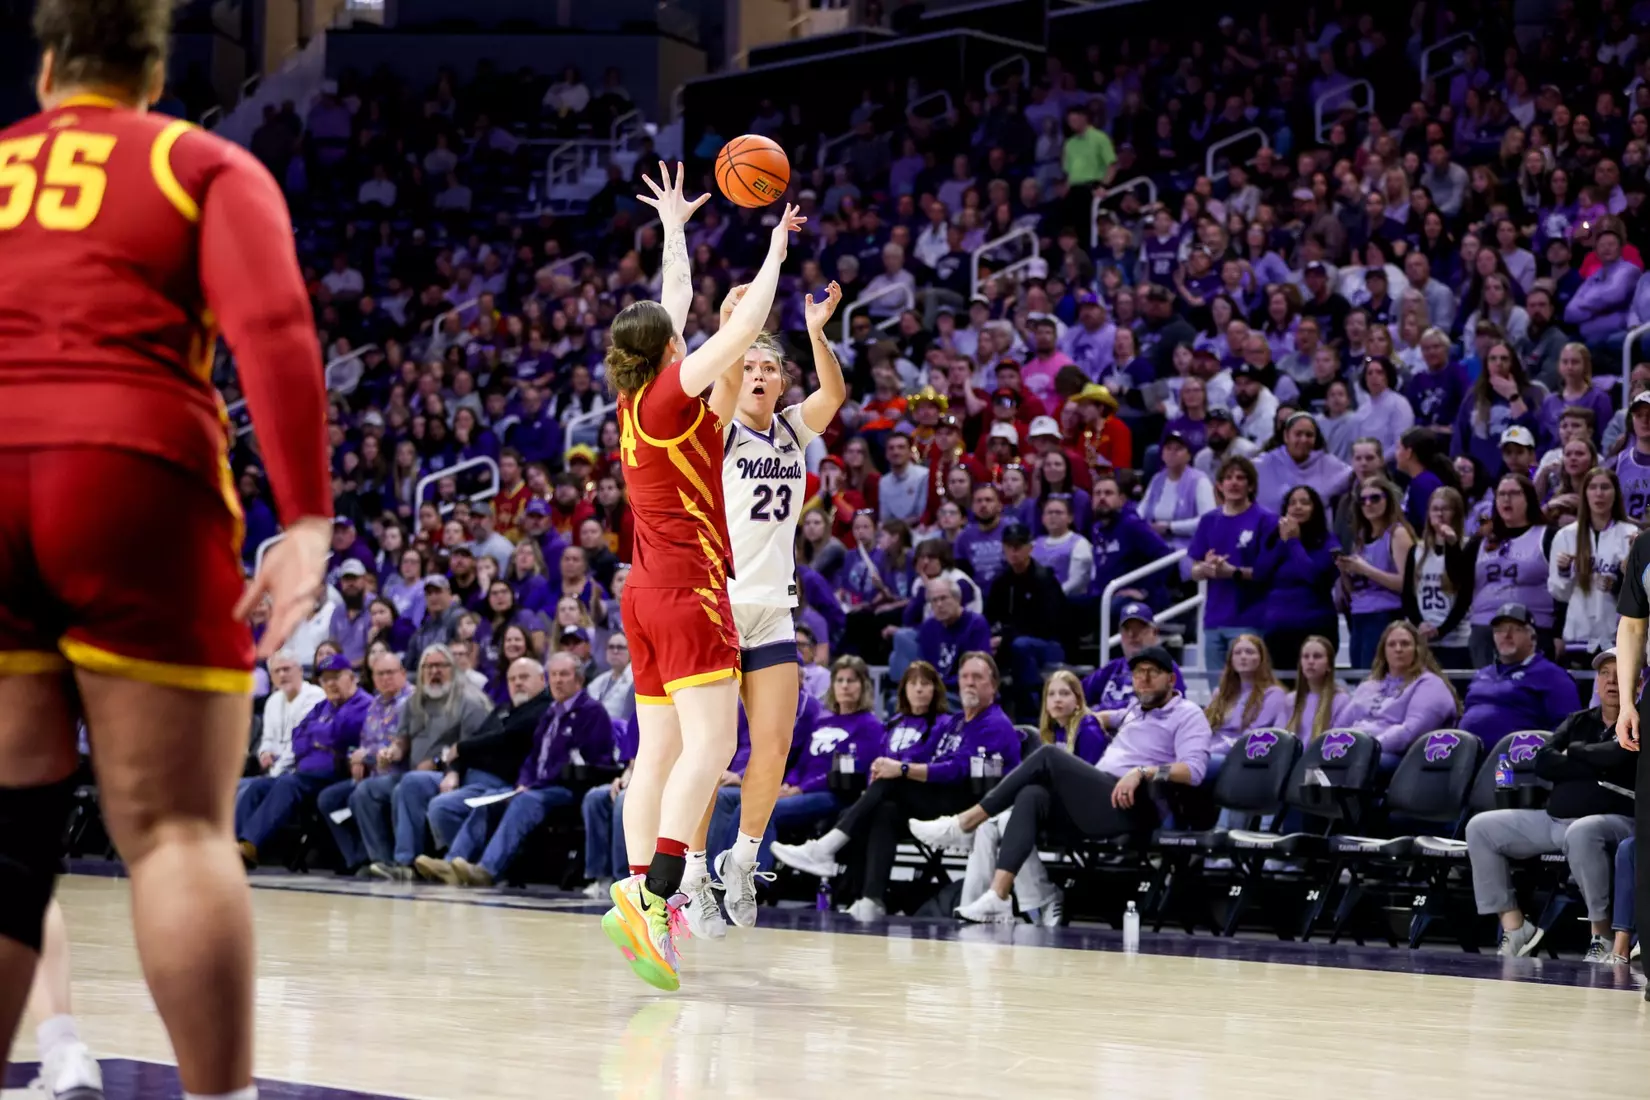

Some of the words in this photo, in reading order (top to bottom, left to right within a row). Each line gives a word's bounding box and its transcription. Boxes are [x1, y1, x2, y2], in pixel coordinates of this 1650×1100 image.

[620, 408, 639, 467] 4
[736, 456, 802, 480] Wildcats
[750, 484, 792, 522] 23
[1486, 563, 1518, 583] 24
[1422, 585, 1446, 610] 25
[1138, 881, 1151, 892] 22
[1229, 886, 1242, 896] 23
[1306, 890, 1320, 900] 24
[1413, 895, 1427, 906] 25
